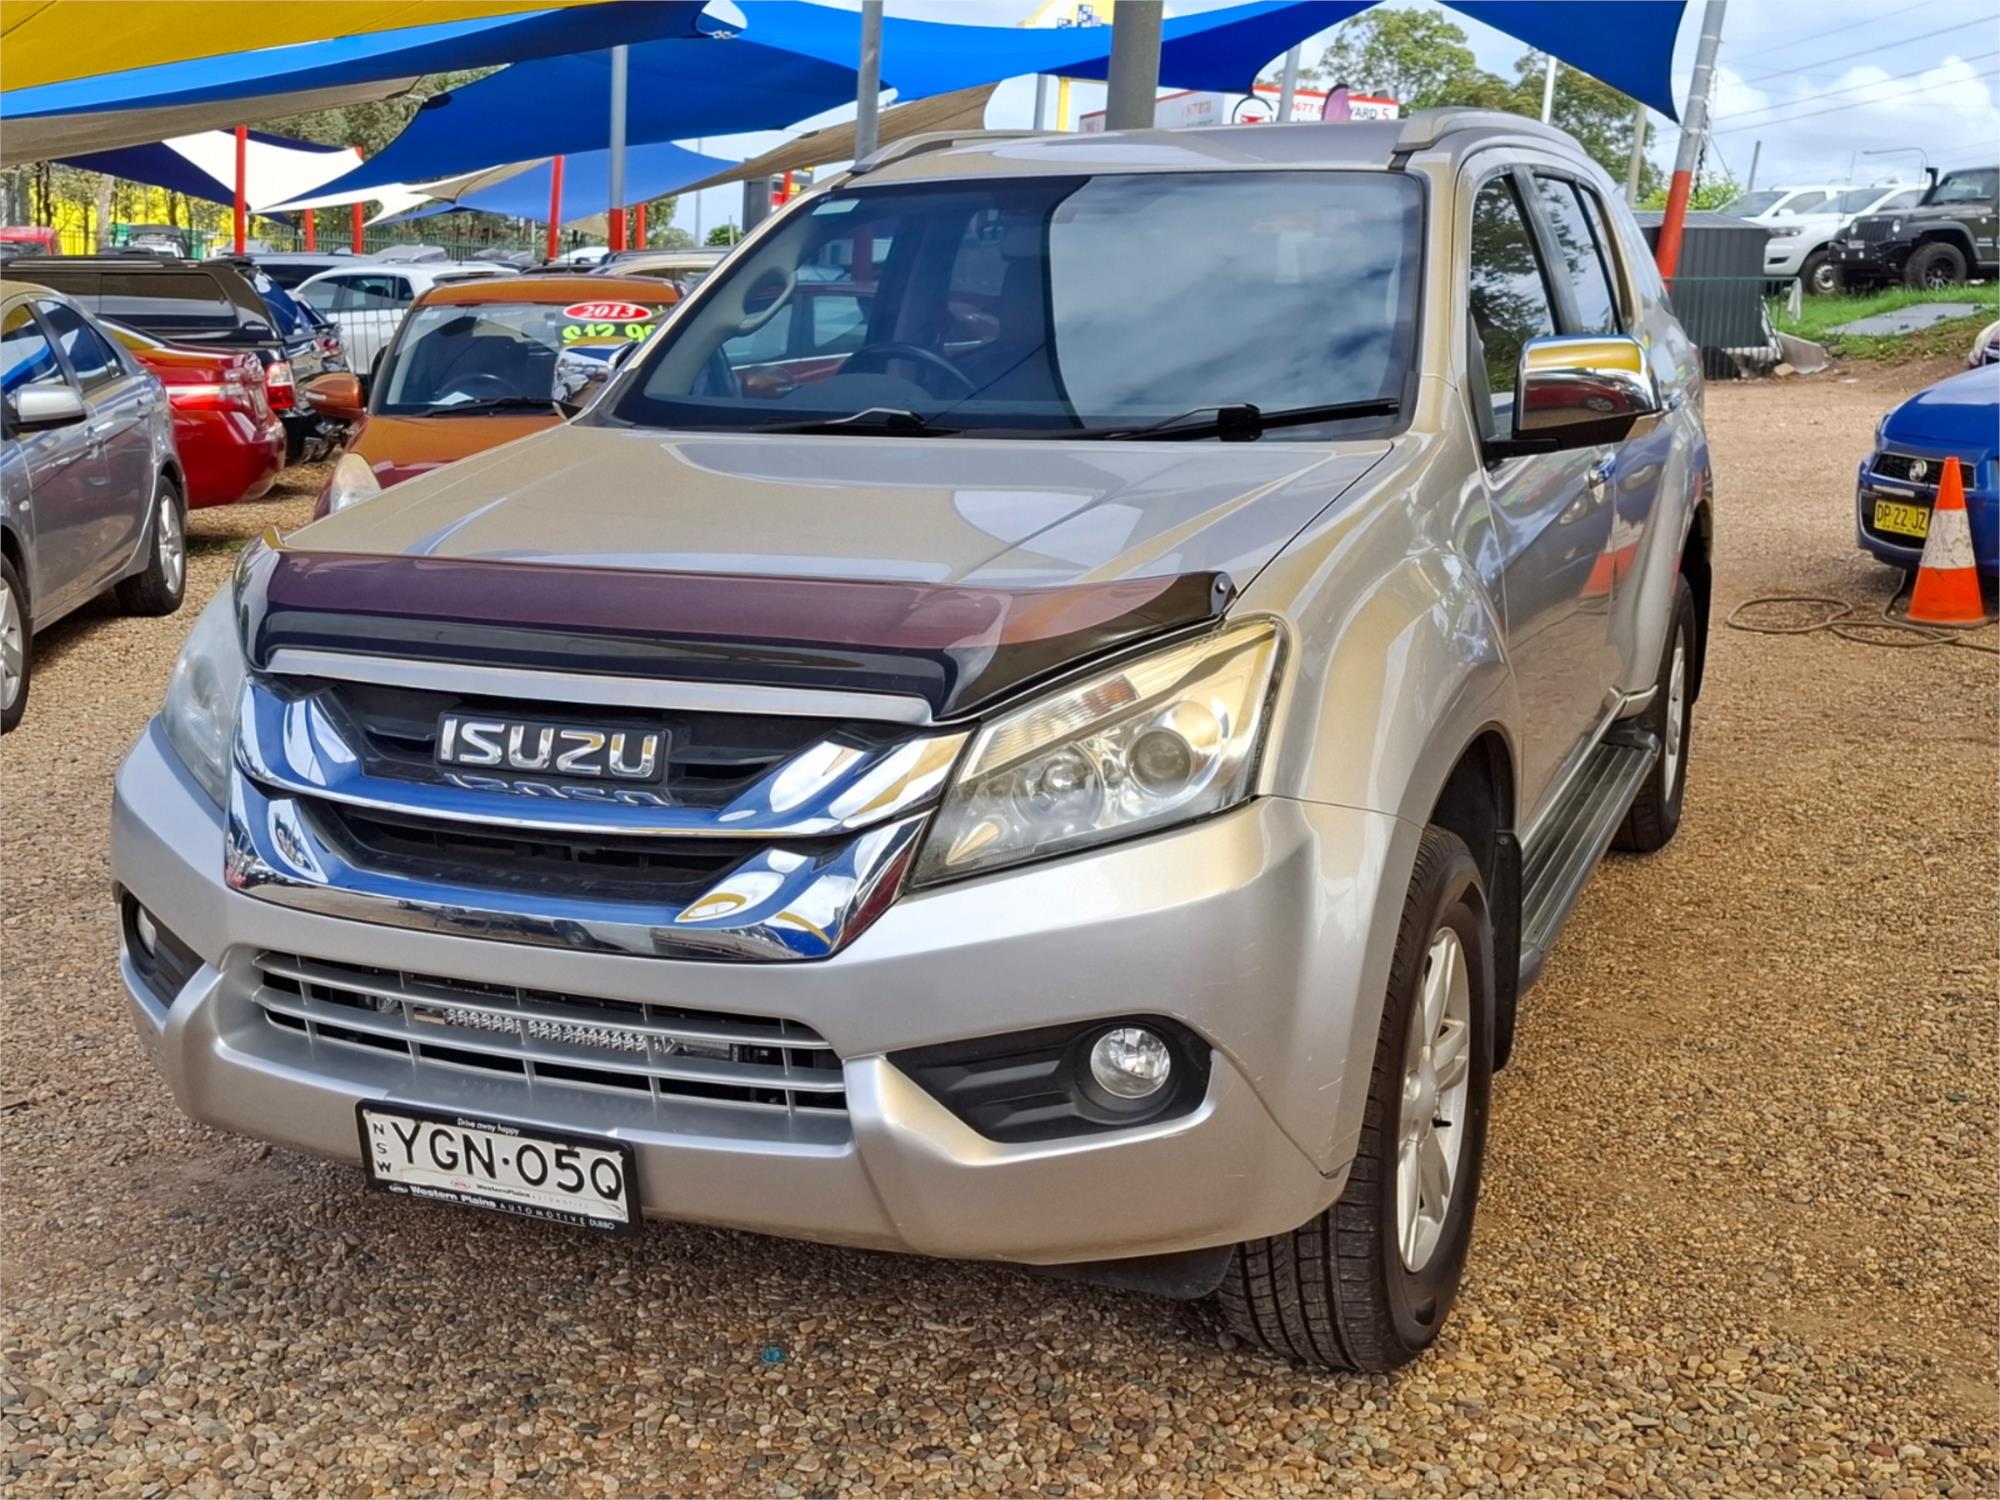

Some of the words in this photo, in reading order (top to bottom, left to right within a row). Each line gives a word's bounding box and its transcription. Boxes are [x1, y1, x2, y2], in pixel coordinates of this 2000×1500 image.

[582, 304, 635, 317] 2013
[440, 718, 658, 778] ISUZU
[457, 1118, 476, 1129] Drive
[477, 1123, 497, 1133] away
[497, 1123, 520, 1136] happy
[409, 1185, 458, 1201] Western
[460, 1194, 497, 1208] Plains
[500, 1202, 586, 1226] AUTOMOTIVE
